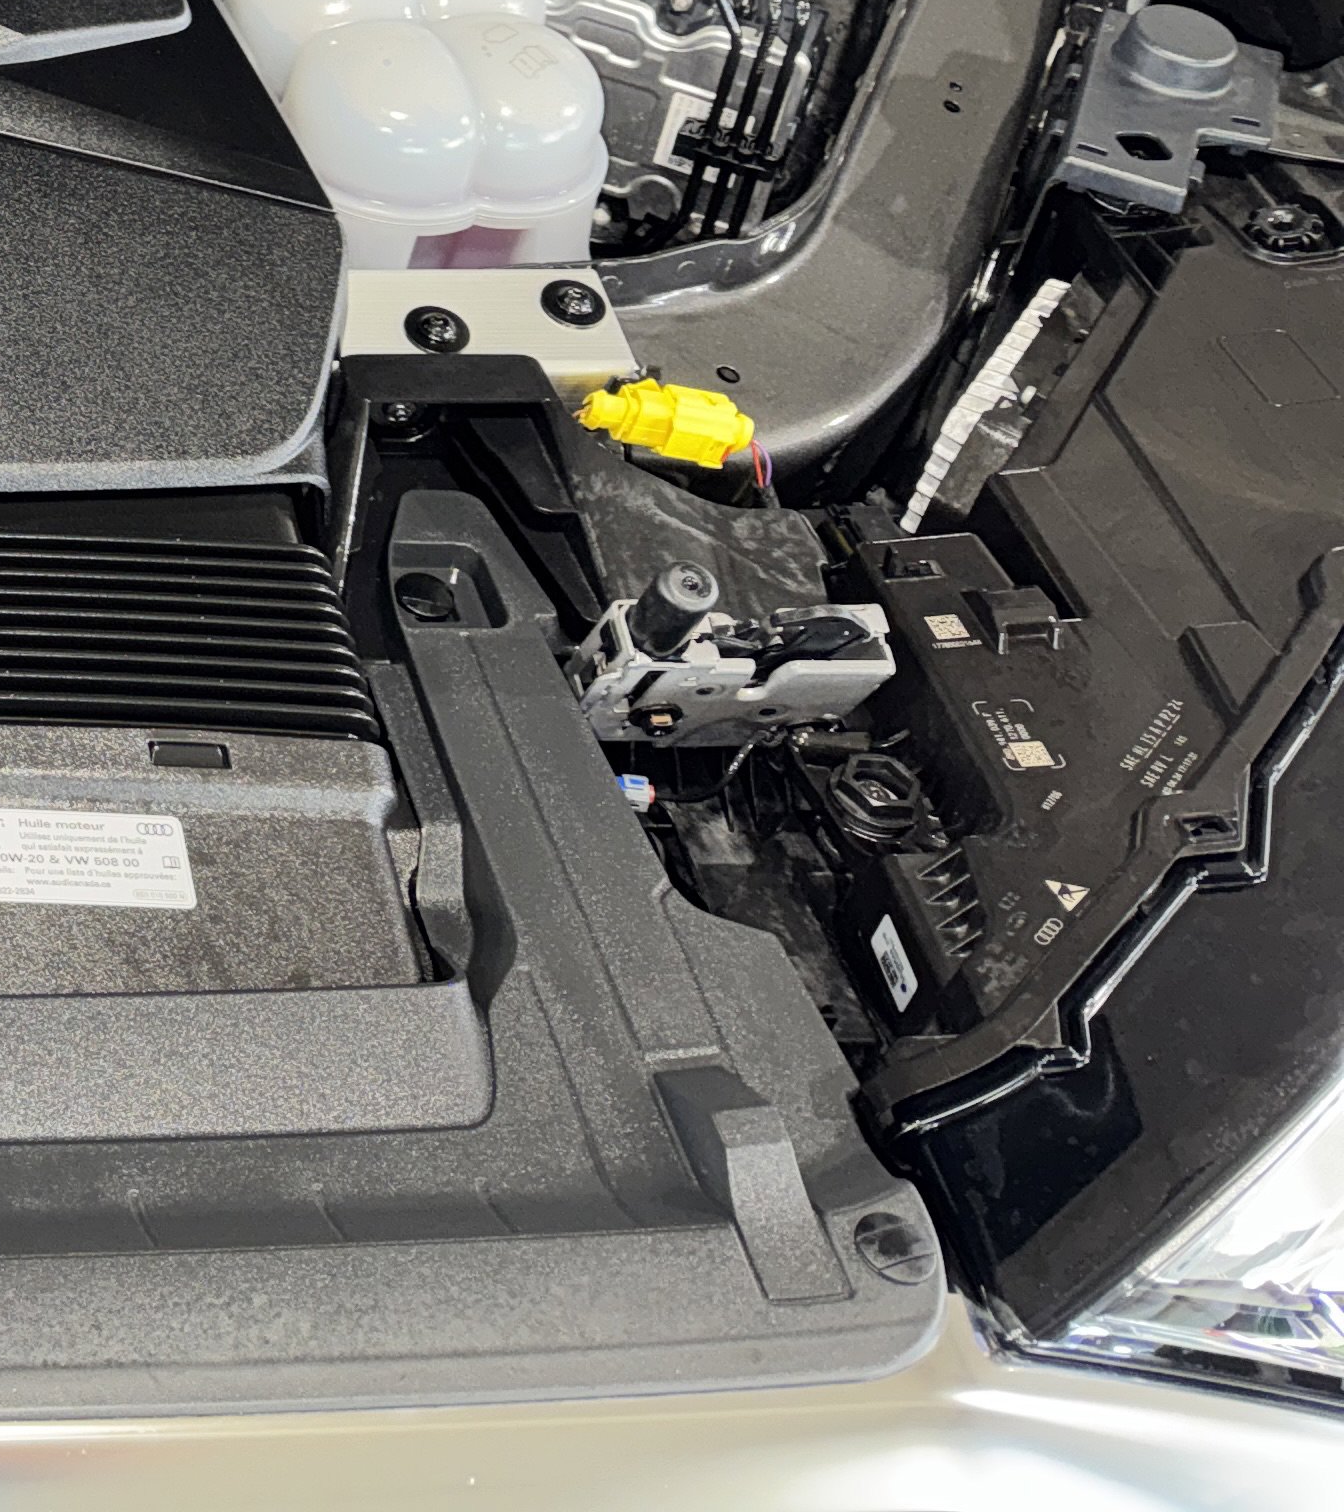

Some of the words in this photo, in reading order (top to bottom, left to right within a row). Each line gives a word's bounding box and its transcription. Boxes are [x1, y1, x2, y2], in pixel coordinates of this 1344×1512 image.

[19, 819, 50, 828] Huile
[22, 843, 36, 851] qui
[0, 853, 44, 864] 0W-20
[49, 856, 59, 864] &
[64, 856, 89, 864] VW
[95, 858, 118, 866] 508
[123, 858, 139, 867] 00
